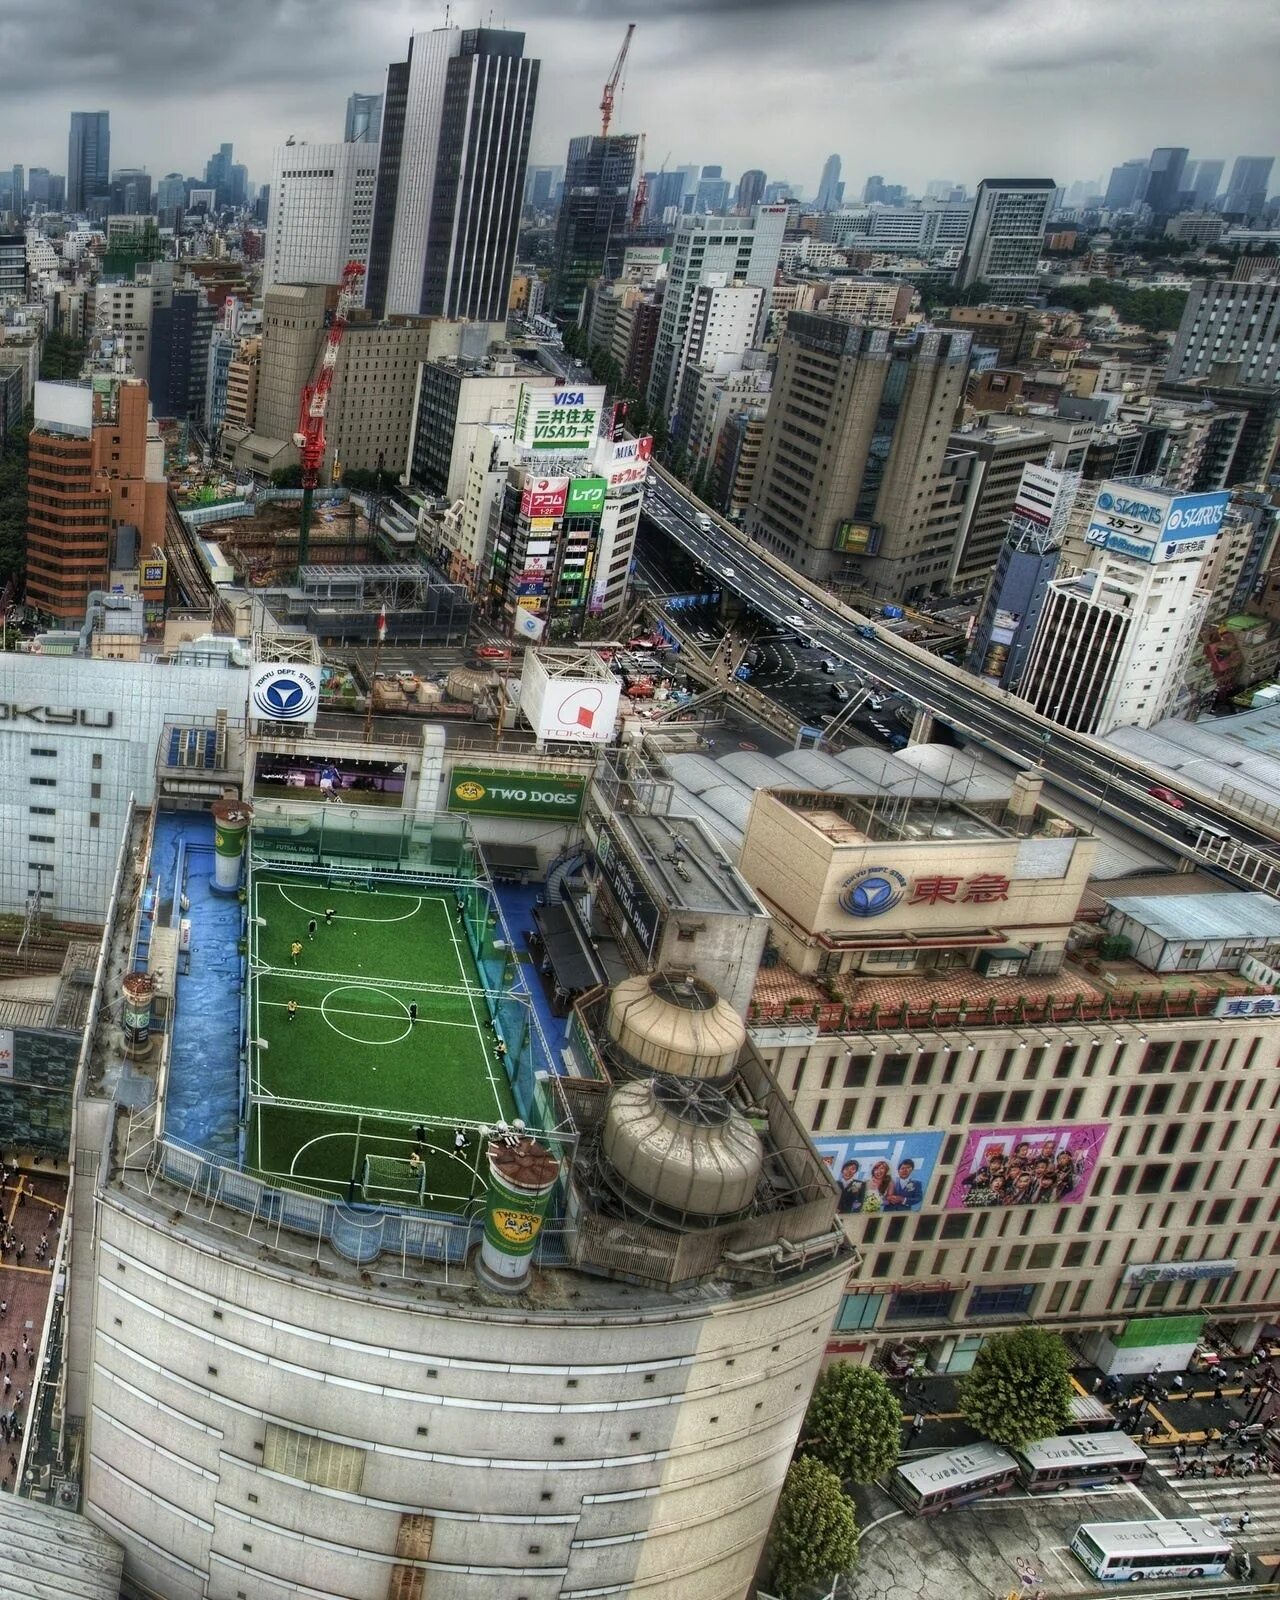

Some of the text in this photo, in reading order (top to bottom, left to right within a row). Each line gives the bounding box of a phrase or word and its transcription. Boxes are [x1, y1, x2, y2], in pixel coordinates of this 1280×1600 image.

[552, 392, 585, 406] VISA
[535, 408, 597, 425] 三井住友
[534, 425, 594, 439] VISAカード
[534, 494, 562, 506] アコム
[572, 488, 602, 501] レイク
[1106, 516, 1144, 535] スターツ
[1089, 528, 1107, 543] OZ
[255, 668, 317, 690] TOKYU DEPT. STORE
[543, 729, 609, 740] TOKYU
[487, 787, 577, 804] TWO DOGS
[276, 844, 298, 852] FUTSAL
[843, 870, 867, 888] TOKYU
[614, 875, 634, 920] FUTSAL
[908, 873, 1011, 906] 東急
[1223, 999, 1280, 1016] 東急
[495, 1210, 518, 1219] TWO
